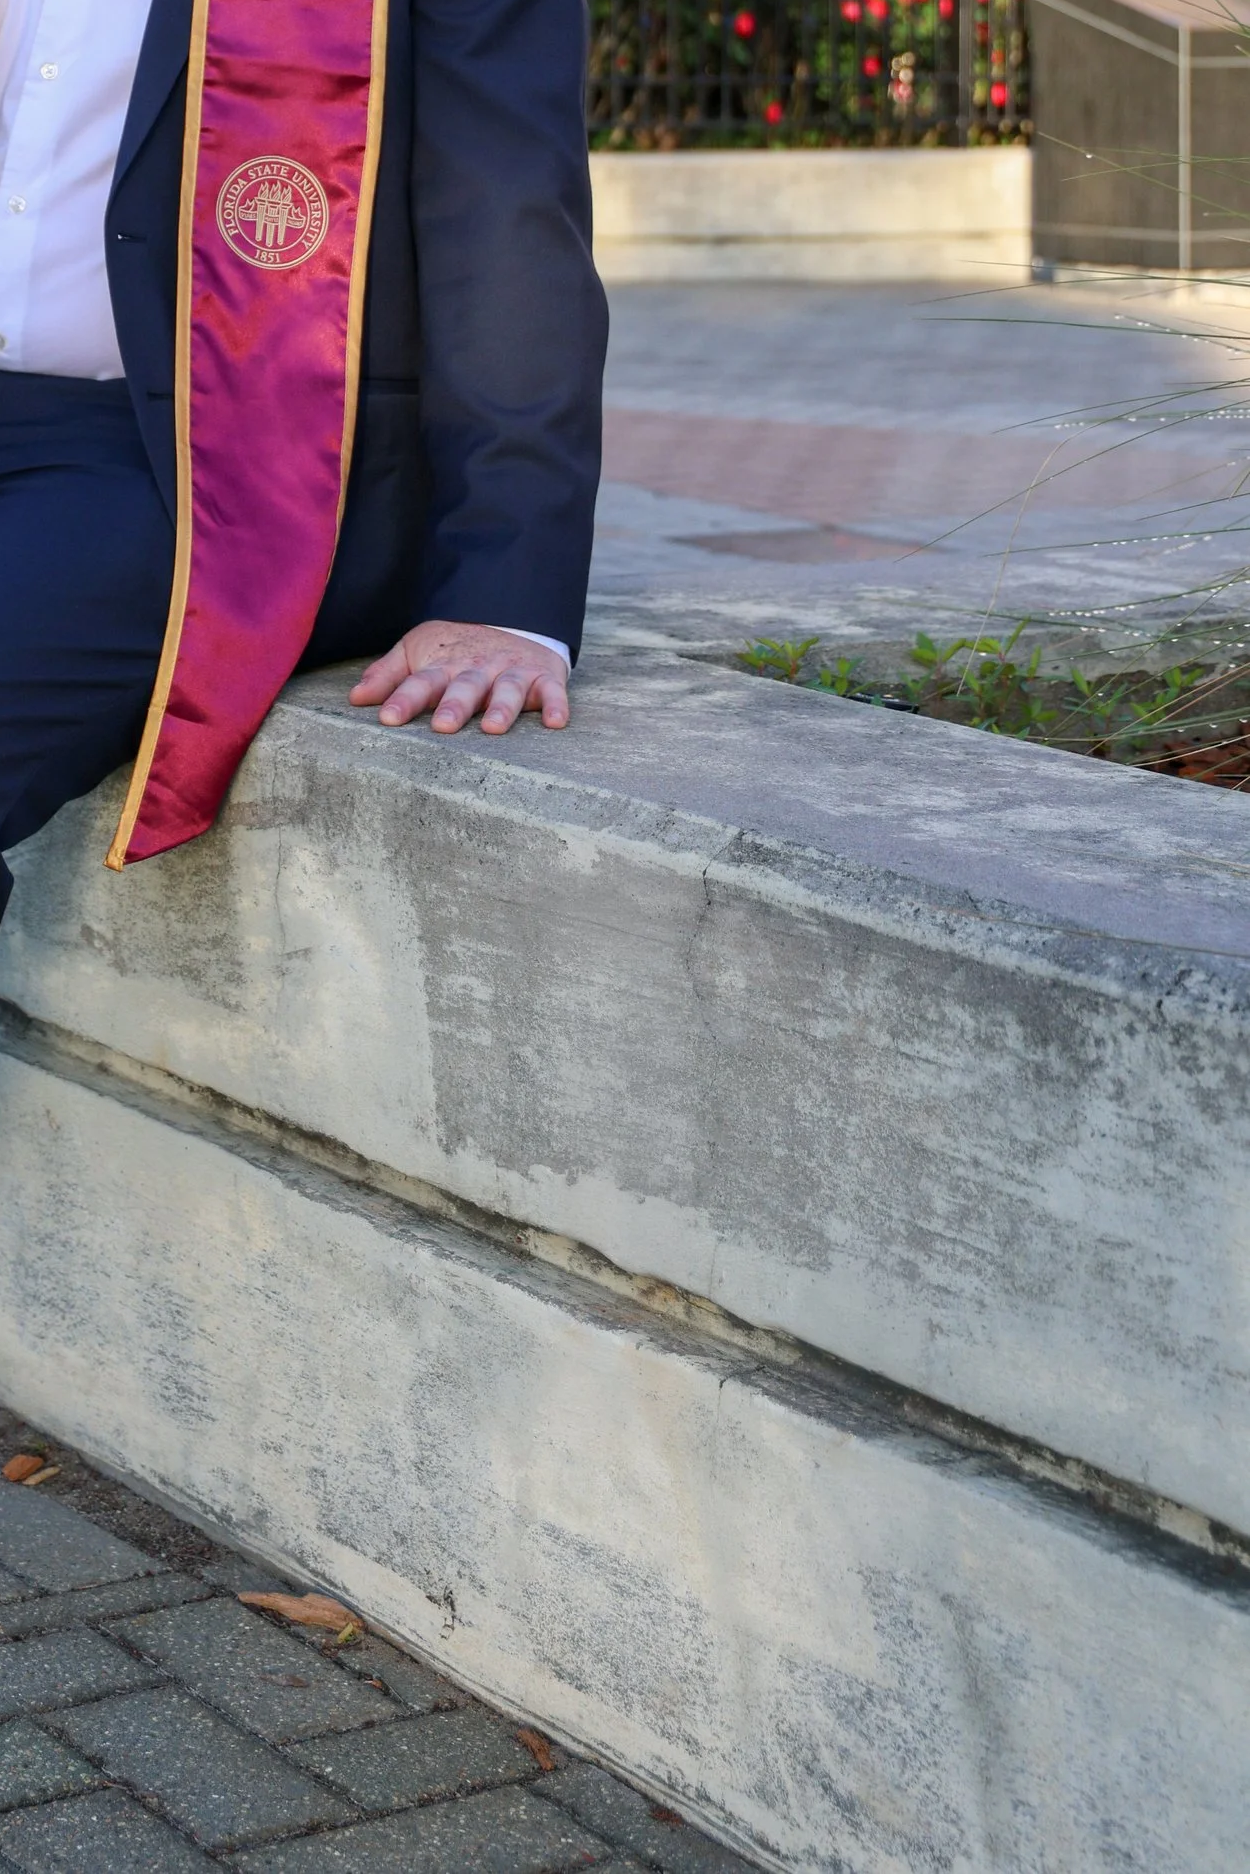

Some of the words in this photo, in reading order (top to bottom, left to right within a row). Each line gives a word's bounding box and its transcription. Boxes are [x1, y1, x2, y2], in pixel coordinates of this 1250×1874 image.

[223, 178, 248, 236] FLORIDA
[248, 164, 289, 179] STATE
[292, 172, 321, 250] UNIVERSITY
[254, 250, 280, 263] 1851
